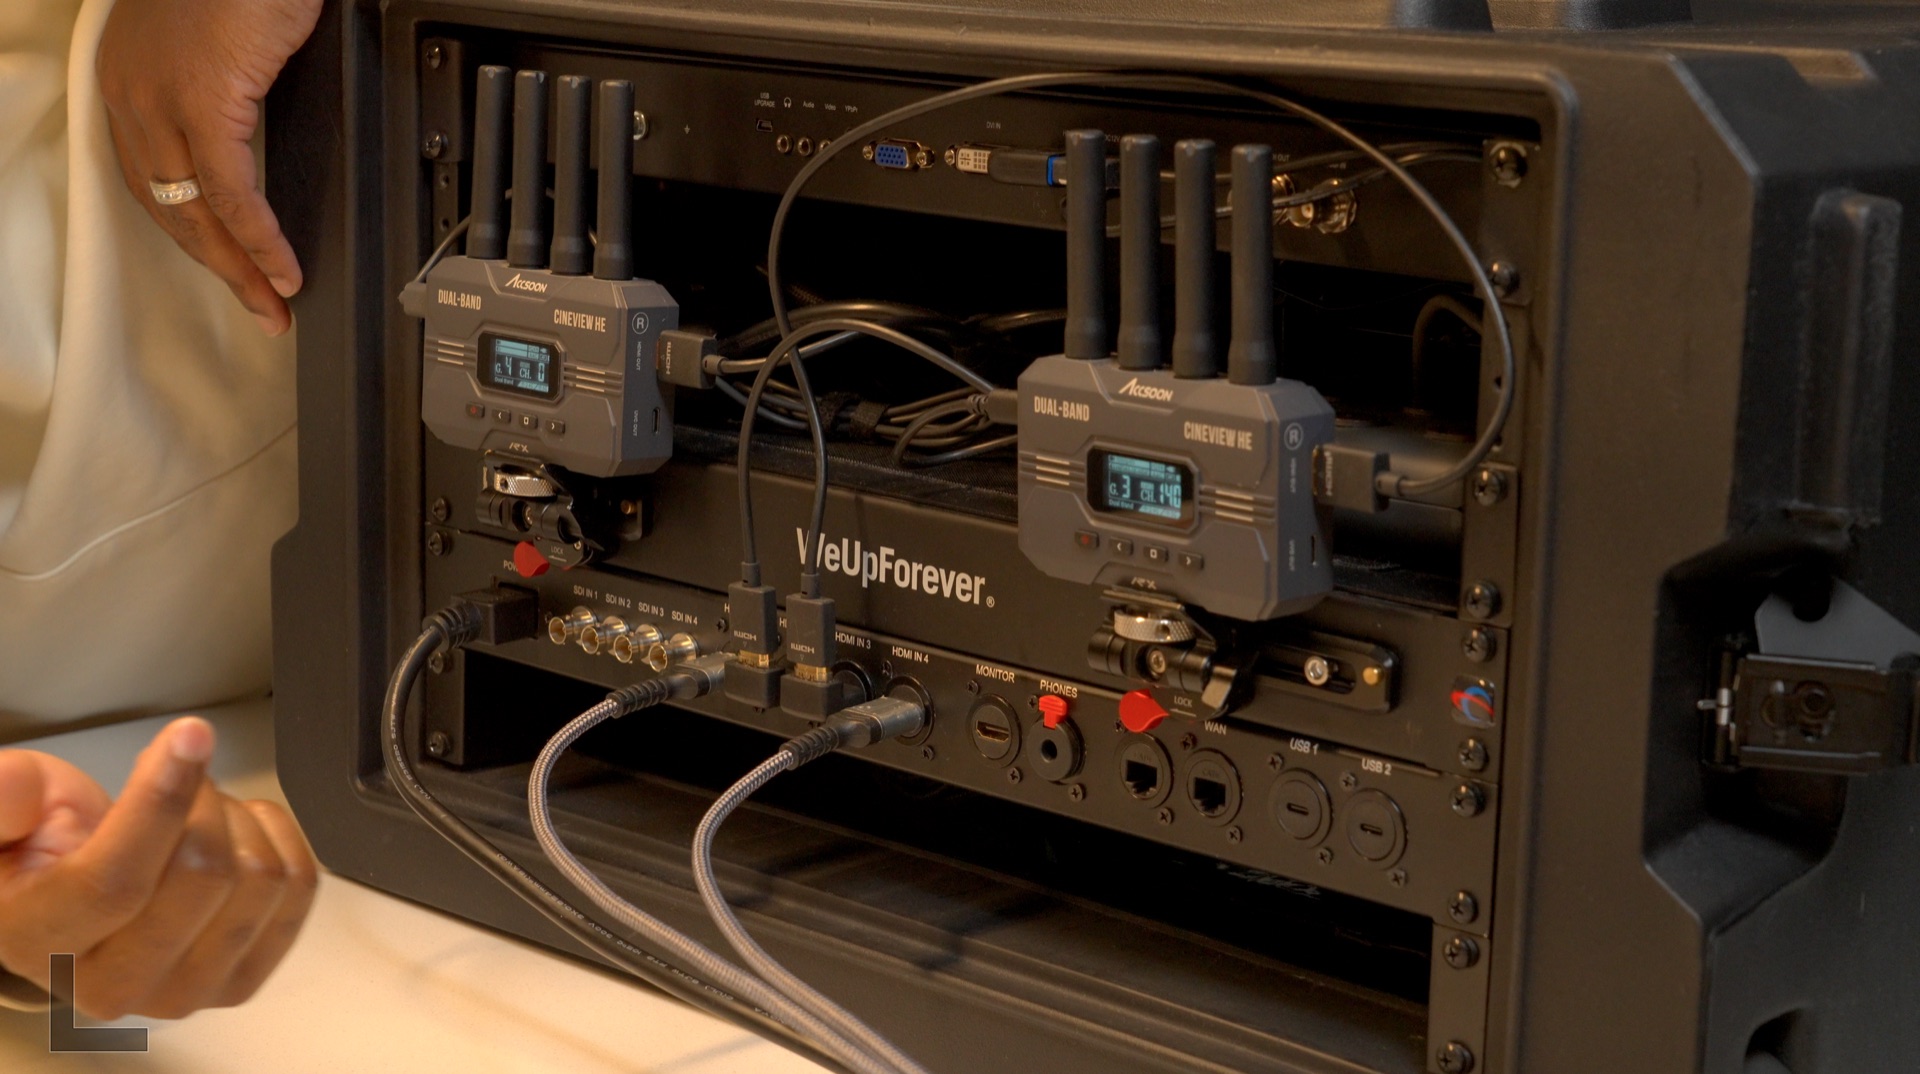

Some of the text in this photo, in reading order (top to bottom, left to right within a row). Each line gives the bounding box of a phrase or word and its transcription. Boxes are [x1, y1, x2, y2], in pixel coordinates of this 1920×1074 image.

[438, 289, 482, 311] DUAL-BAND
[553, 309, 606, 333] CINEVIEW HE
[505, 355, 512, 376] 4
[538, 362, 545, 382] 0
[1033, 395, 1090, 422] DUAL-BAND
[1183, 421, 1253, 451] CINEVIEW HE
[1122, 474, 1131, 499] 3
[550, 545, 564, 555] LOCK
[574, 585, 598, 600] SDI IN 1
[606, 593, 631, 608] SDI IN 2
[638, 602, 664, 617] SDI IN 3
[671, 610, 698, 626] SDI IN 4
[733, 630, 757, 641] HDMI
[835, 631, 872, 649] HDMI IN 3
[790, 642, 815, 654] HDMI
[892, 646, 929, 664] HDMI IN 4
[976, 664, 1015, 684] MONITOR
[1040, 680, 1078, 698] PHONES
[1174, 695, 1193, 708] LOCK
[1204, 720, 1227, 736] WAN
[1290, 737, 1319, 756] USB 1
[1361, 758, 1392, 776] USB 2
